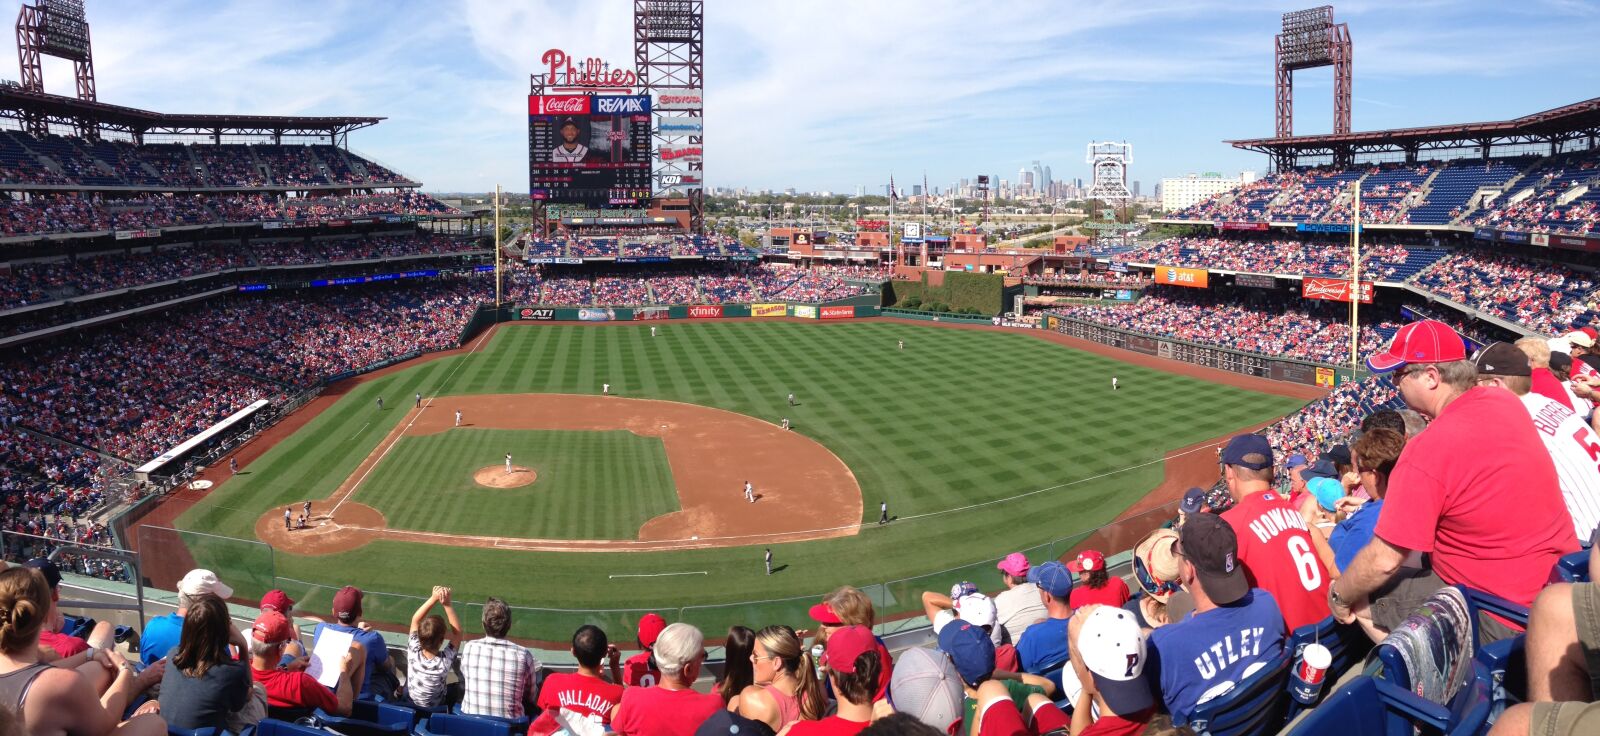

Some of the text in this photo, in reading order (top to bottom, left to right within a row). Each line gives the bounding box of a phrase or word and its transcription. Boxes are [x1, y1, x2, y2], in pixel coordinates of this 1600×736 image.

[542, 48, 636, 87] Phillies
[546, 98, 585, 112] Coca-Cola
[598, 97, 643, 113] RE/MAX
[560, 208, 648, 218] Citizens Bank Park
[1178, 272, 1195, 282] at&t
[1304, 282, 1346, 294] Budweiser
[1348, 283, 1371, 291] GAB
[531, 309, 554, 317] ATI
[690, 306, 720, 317] xfinity
[1287, 535, 1322, 592] 6
[1194, 627, 1264, 680] UTLEY
[1126, 653, 1139, 677] P
[558, 690, 614, 715] HALLADAY
